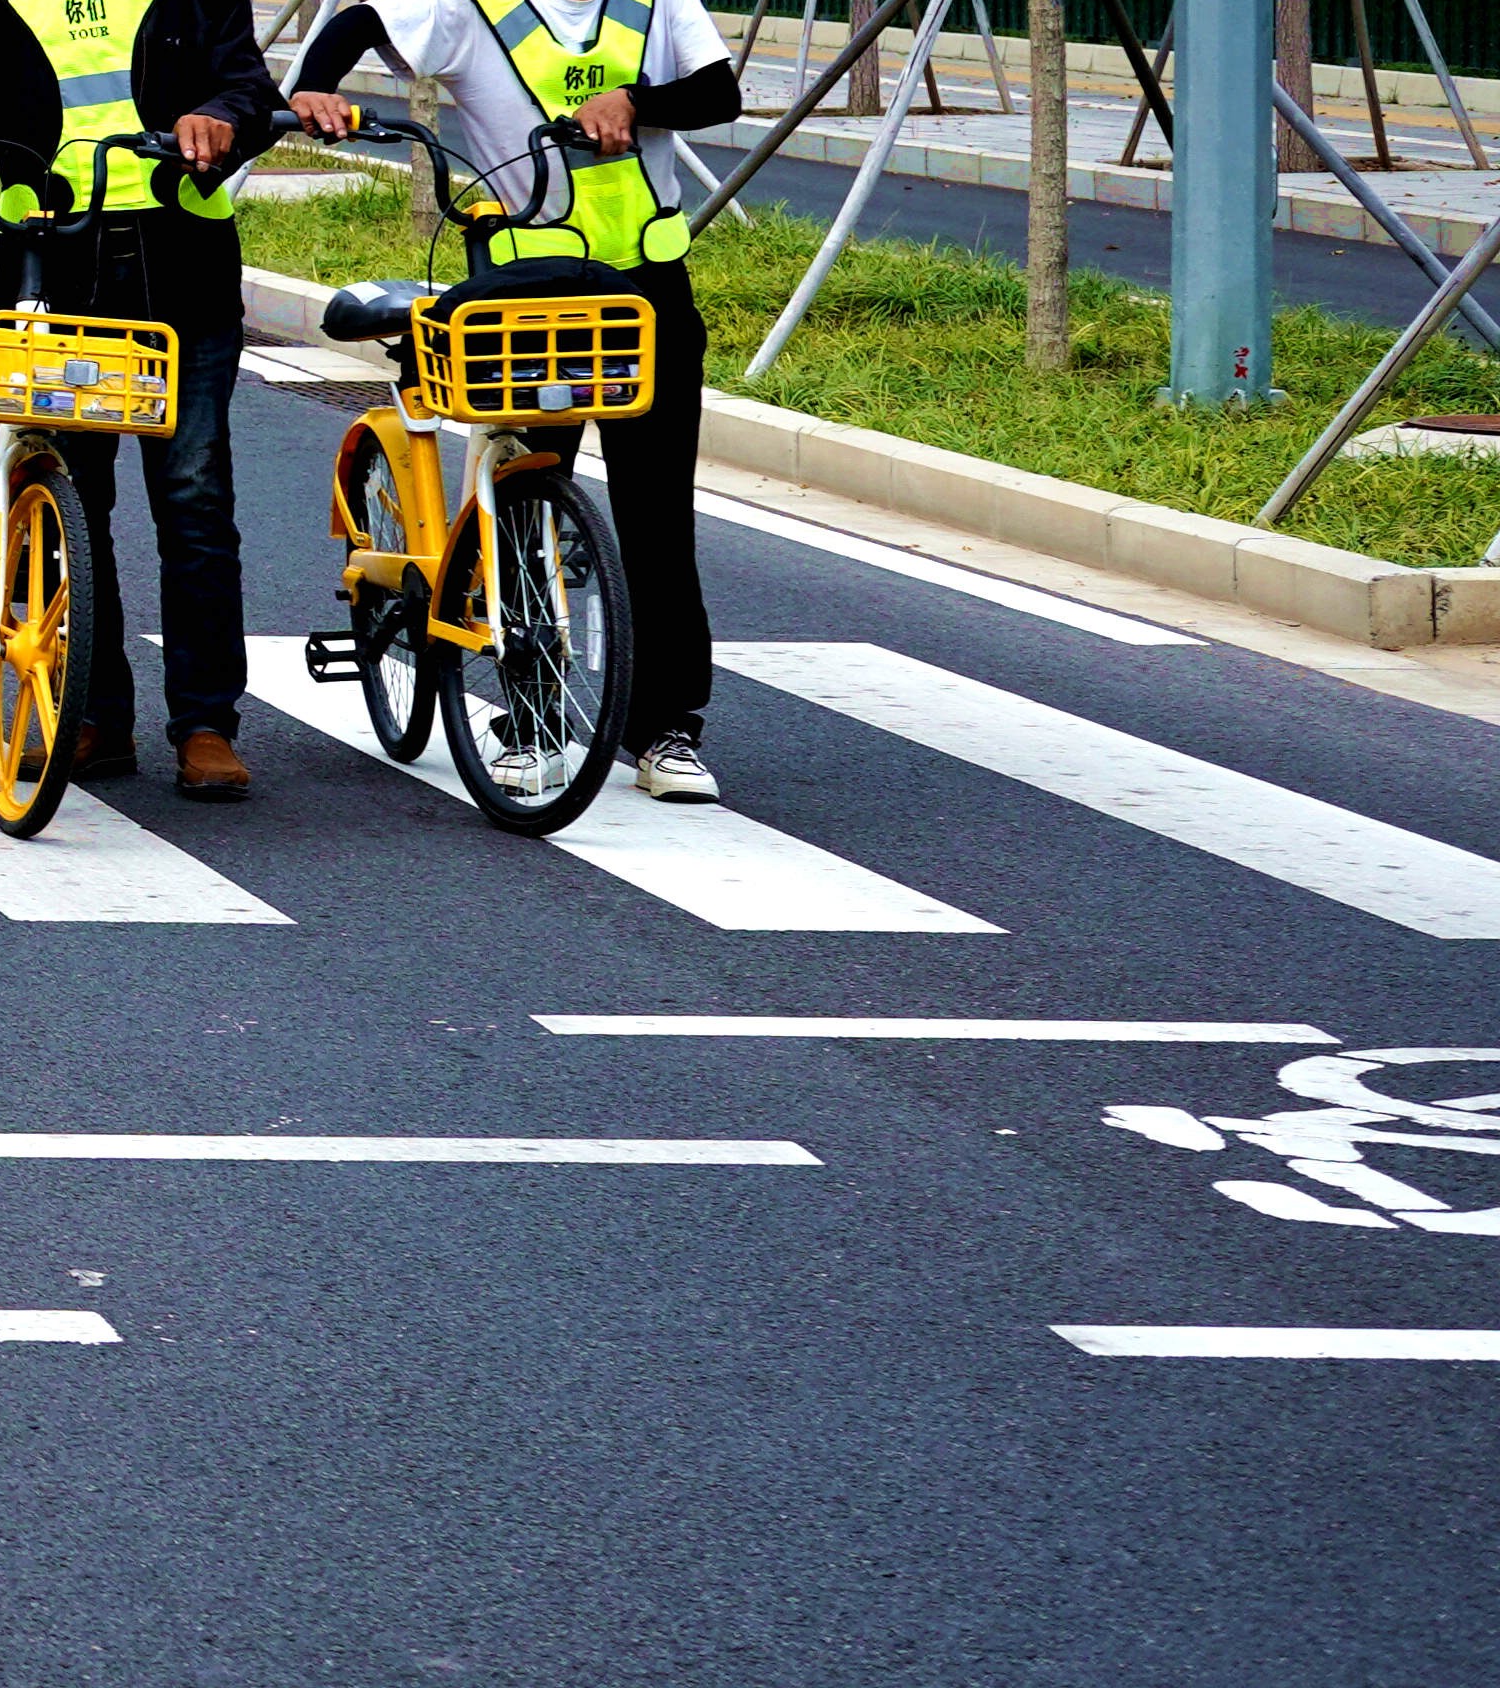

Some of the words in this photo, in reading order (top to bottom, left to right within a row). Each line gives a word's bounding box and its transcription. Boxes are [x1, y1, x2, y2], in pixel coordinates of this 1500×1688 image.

[68, 25, 110, 41] YOUR
[564, 64, 604, 90] 你们
[564, 92, 602, 106] YO
